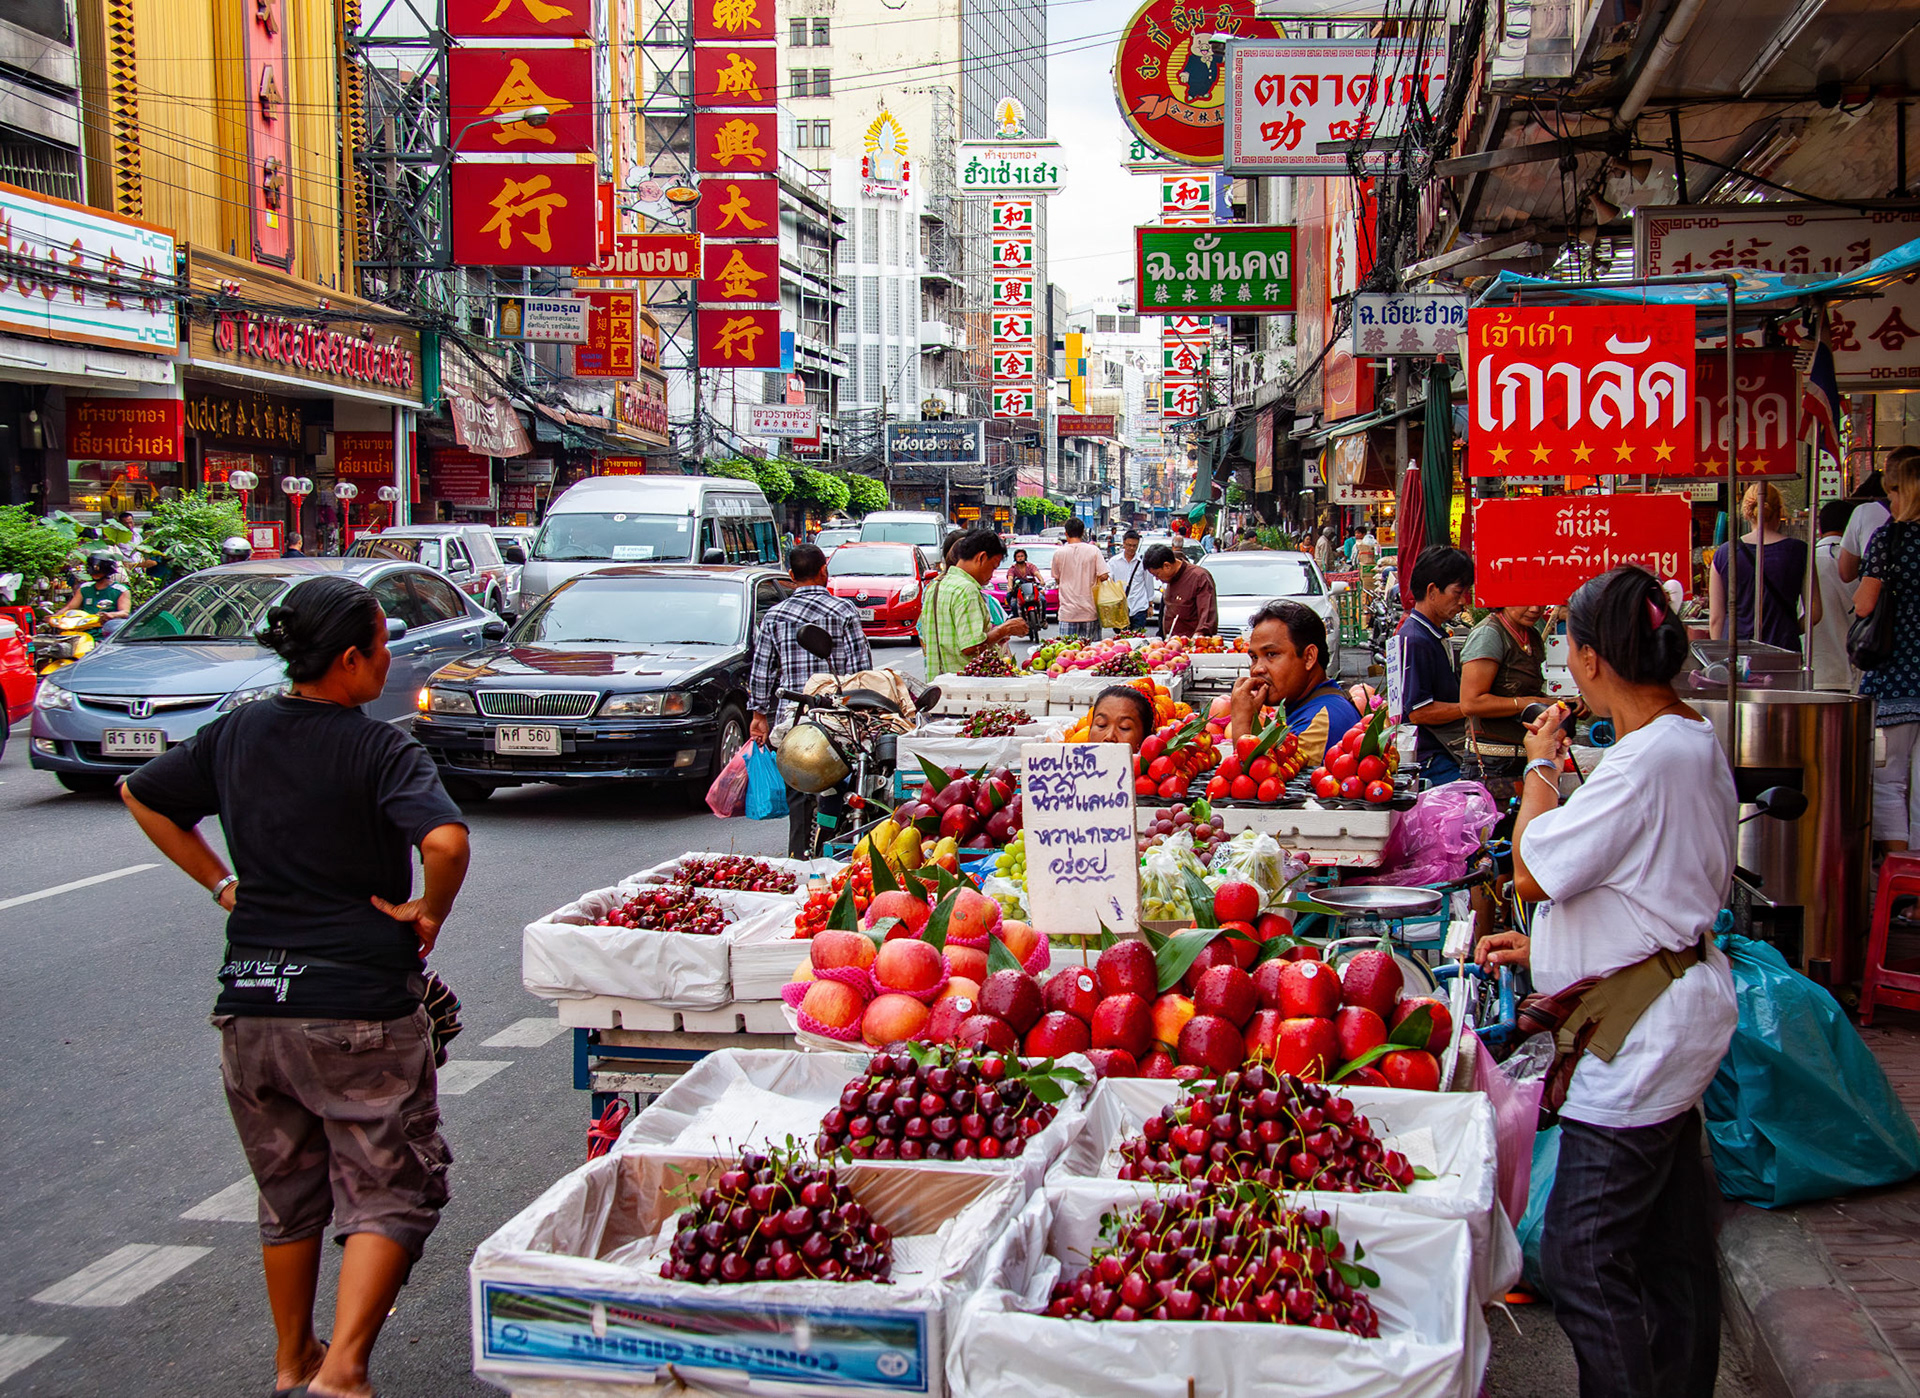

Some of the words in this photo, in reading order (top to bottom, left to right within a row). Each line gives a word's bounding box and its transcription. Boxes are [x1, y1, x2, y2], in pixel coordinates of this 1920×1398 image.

[964, 156, 1058, 184] ฮั่วเซ่งเฮง
[1146, 233, 1288, 281] ฉ.มั่นคง
[528, 302, 580, 316] แสงอรุณ
[1002, 206, 1024, 415] 和成興大金行
[1482, 311, 1573, 348] เจ้าเก่า
[78, 403, 166, 423] ห้างขายทอง
[753, 408, 812, 419] เยาวราชทัวร์
[73, 425, 174, 456] เลี่ยงเซ่งเฮง
[133, 732, 157, 744] 616
[528, 729, 552, 742] 560
[565, 1333, 685, 1361] GILBERT
[711, 1346, 839, 1372] CONRAD
